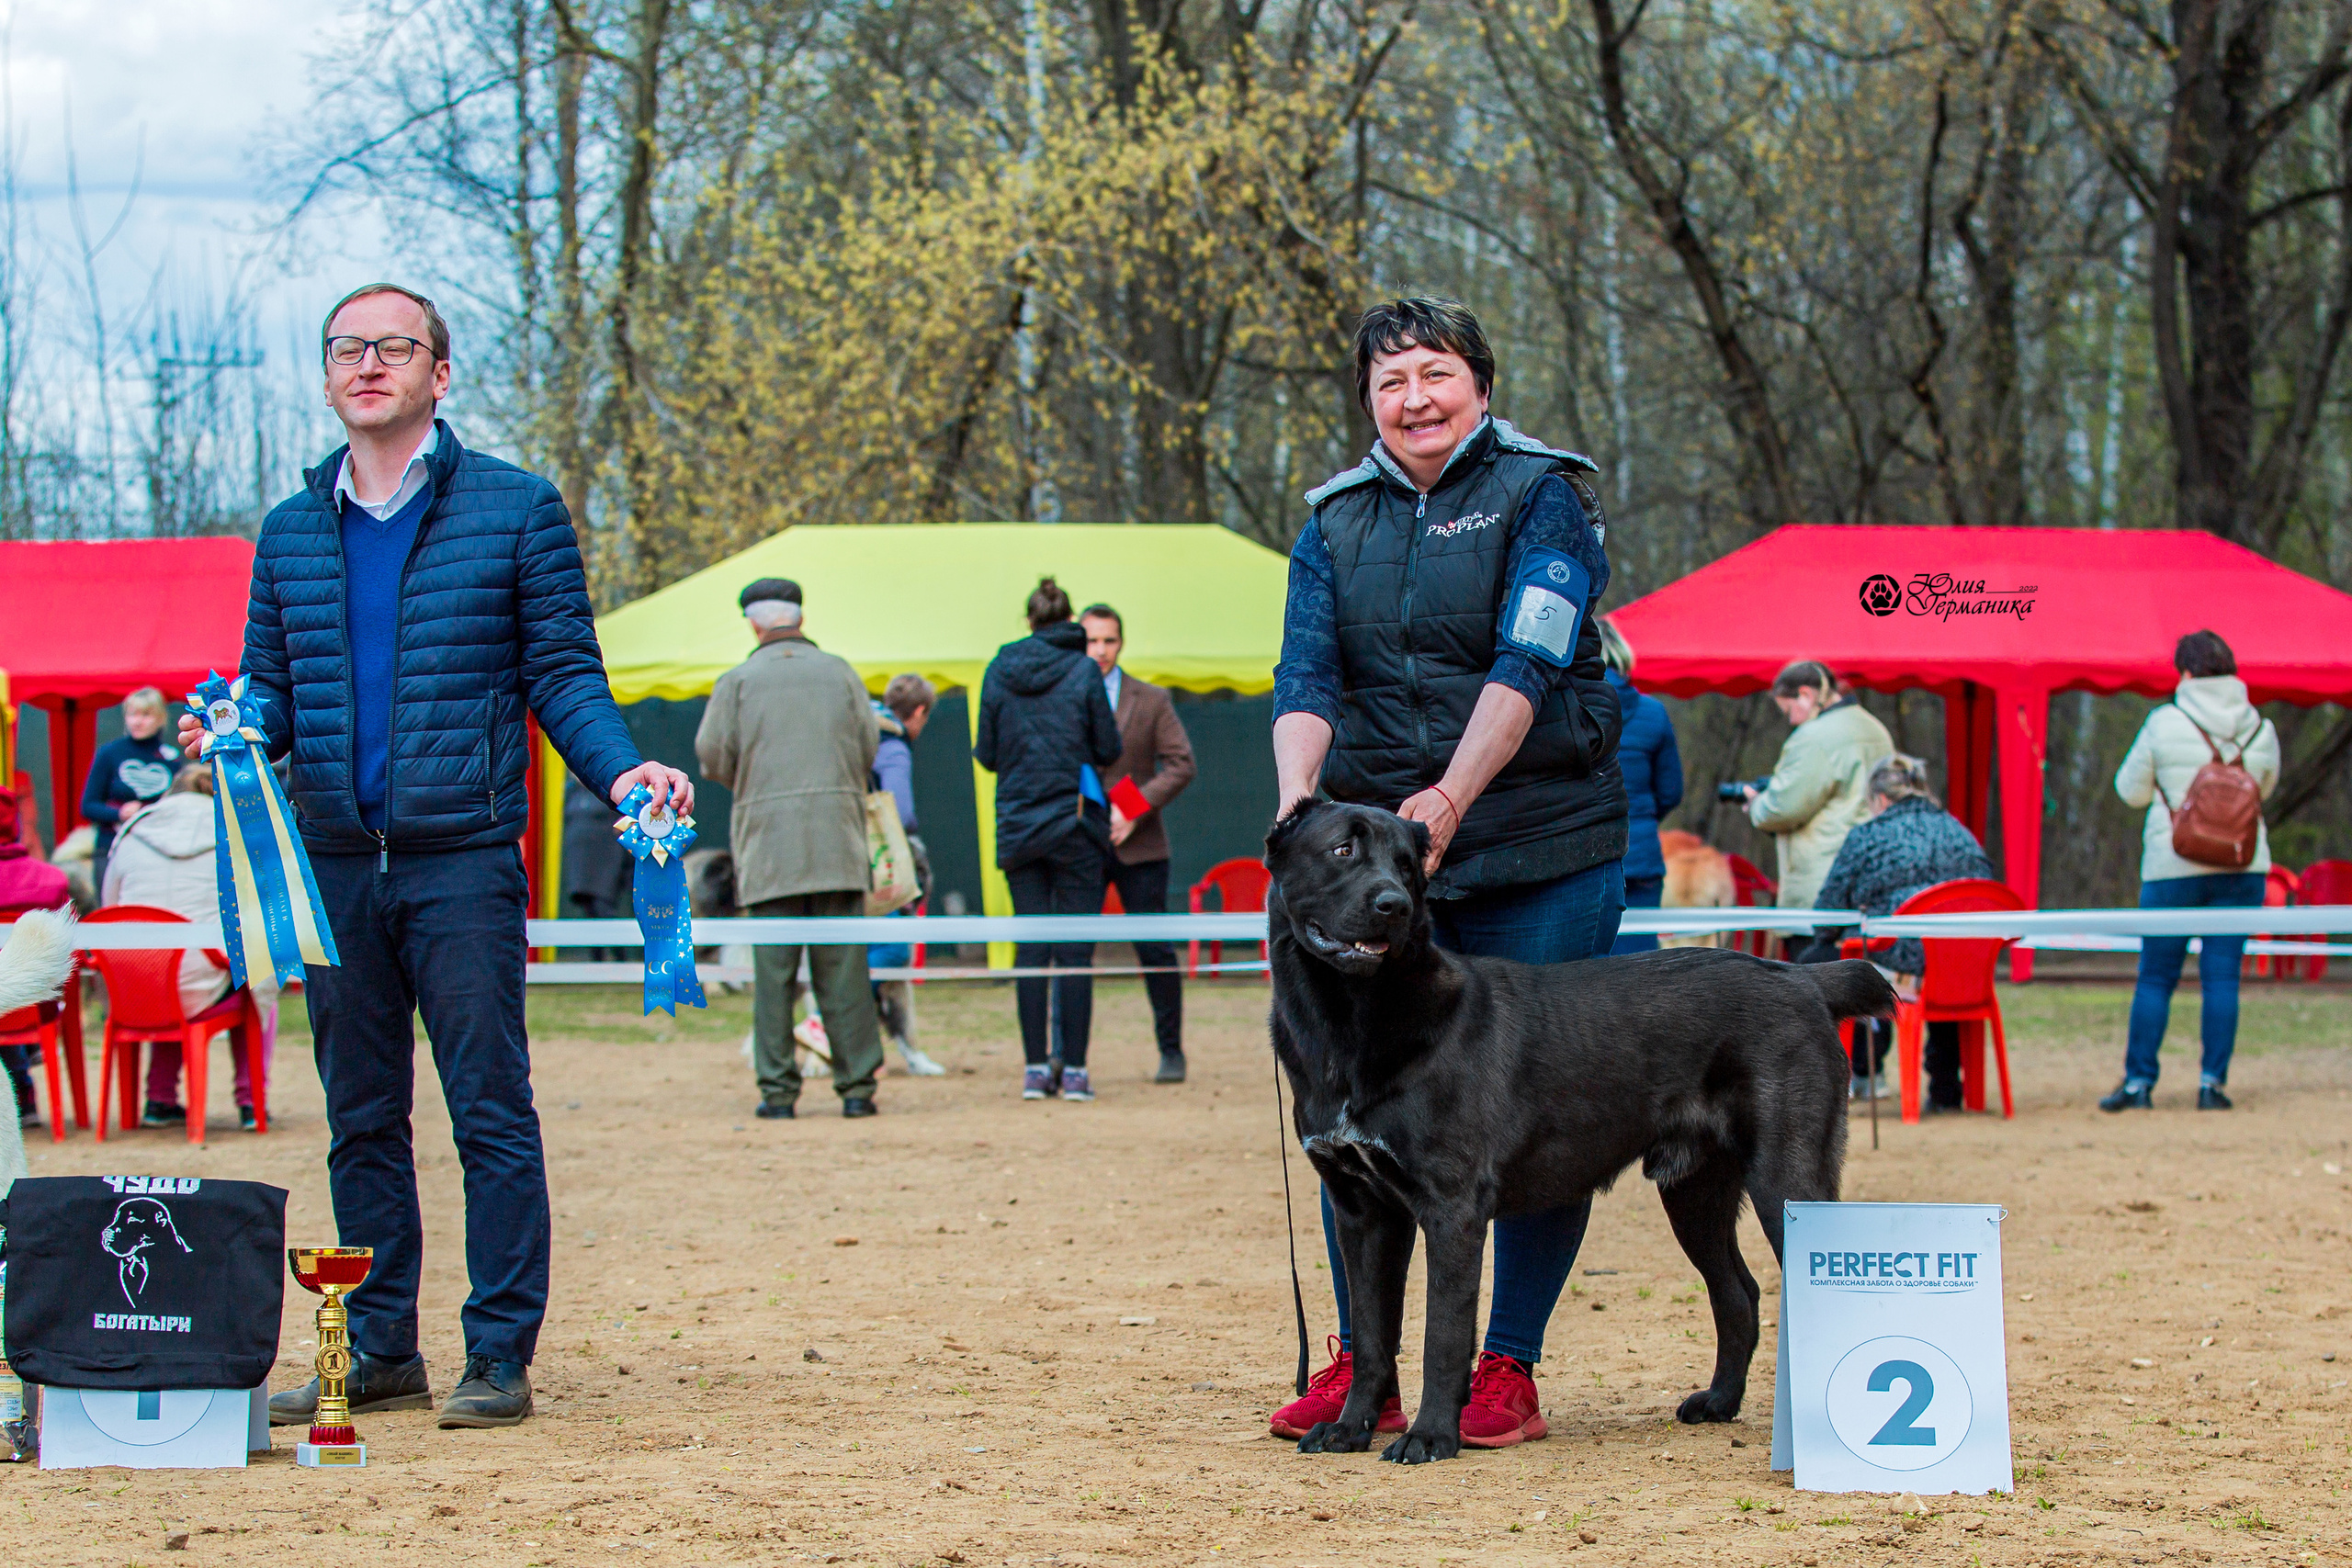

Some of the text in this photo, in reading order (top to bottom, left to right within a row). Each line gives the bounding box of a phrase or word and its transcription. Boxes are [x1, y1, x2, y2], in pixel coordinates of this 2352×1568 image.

[1533, 605, 1557, 621] 5
[102, 1175, 201, 1194] ЧУДО
[1809, 1251, 1978, 1278] PERFECT FIT
[1810, 1279, 1865, 1287] КОМПЛЕКСНАЯ
[1903, 1280, 1941, 1288] ЗДОРОВЬЕ
[94, 1313, 192, 1333] БОГАТЫРИ
[328, 1352, 340, 1370] 1
[1866, 1359, 1936, 1446] 2
